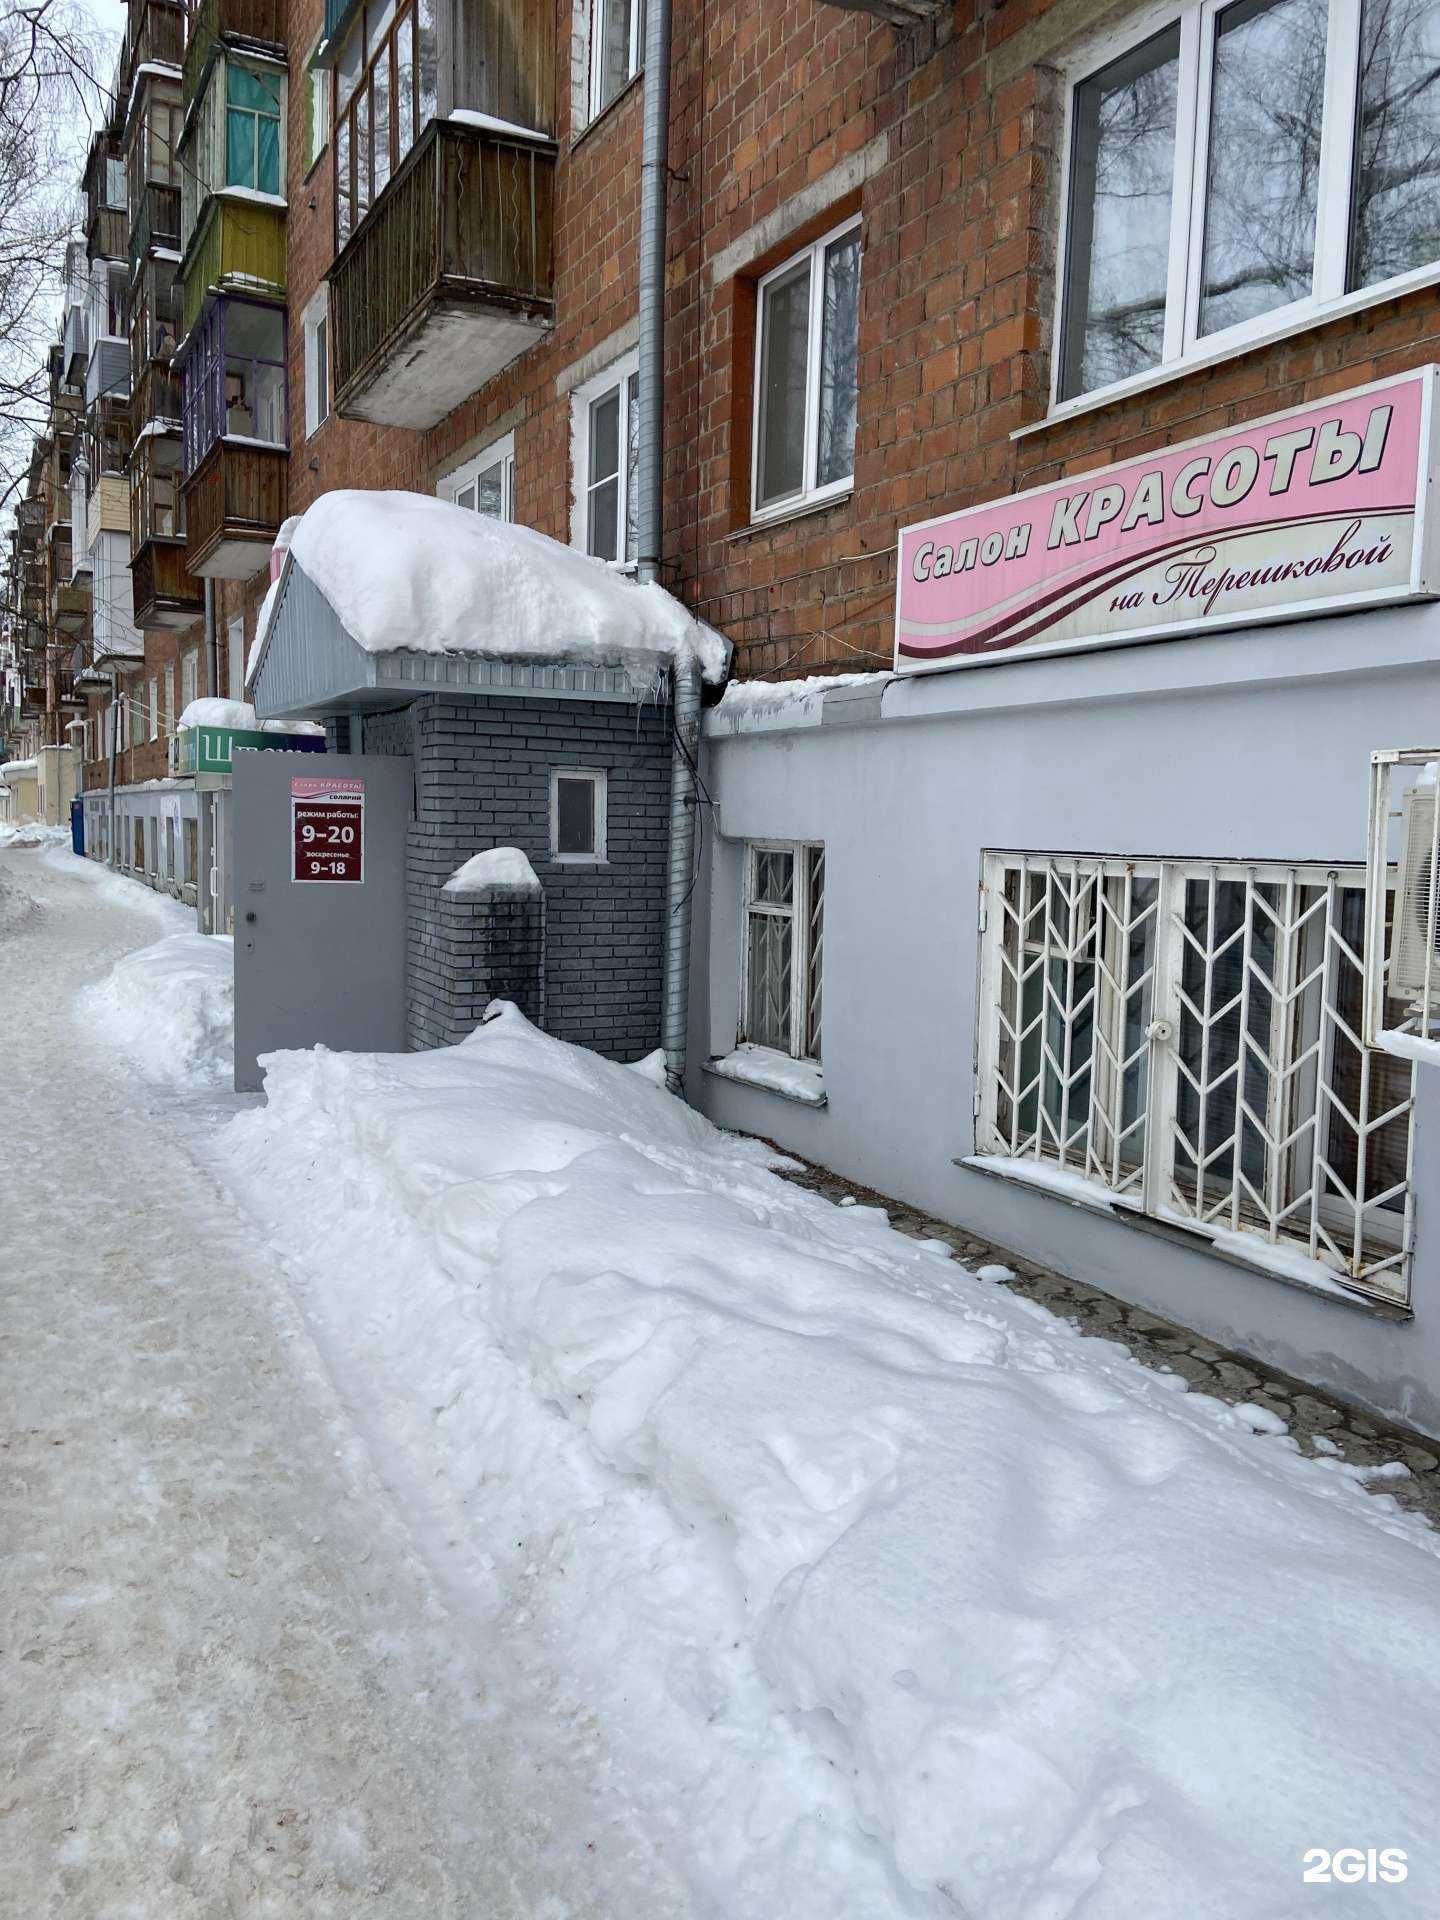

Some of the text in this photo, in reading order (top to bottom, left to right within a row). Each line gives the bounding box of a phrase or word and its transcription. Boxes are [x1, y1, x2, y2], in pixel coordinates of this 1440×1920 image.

[913, 404, 1393, 582] Салон КРАСОТЫ
[1109, 518, 1393, 615] на Терешковой
[297, 810, 325, 819] режим
[310, 861, 346, 874] 9-18
